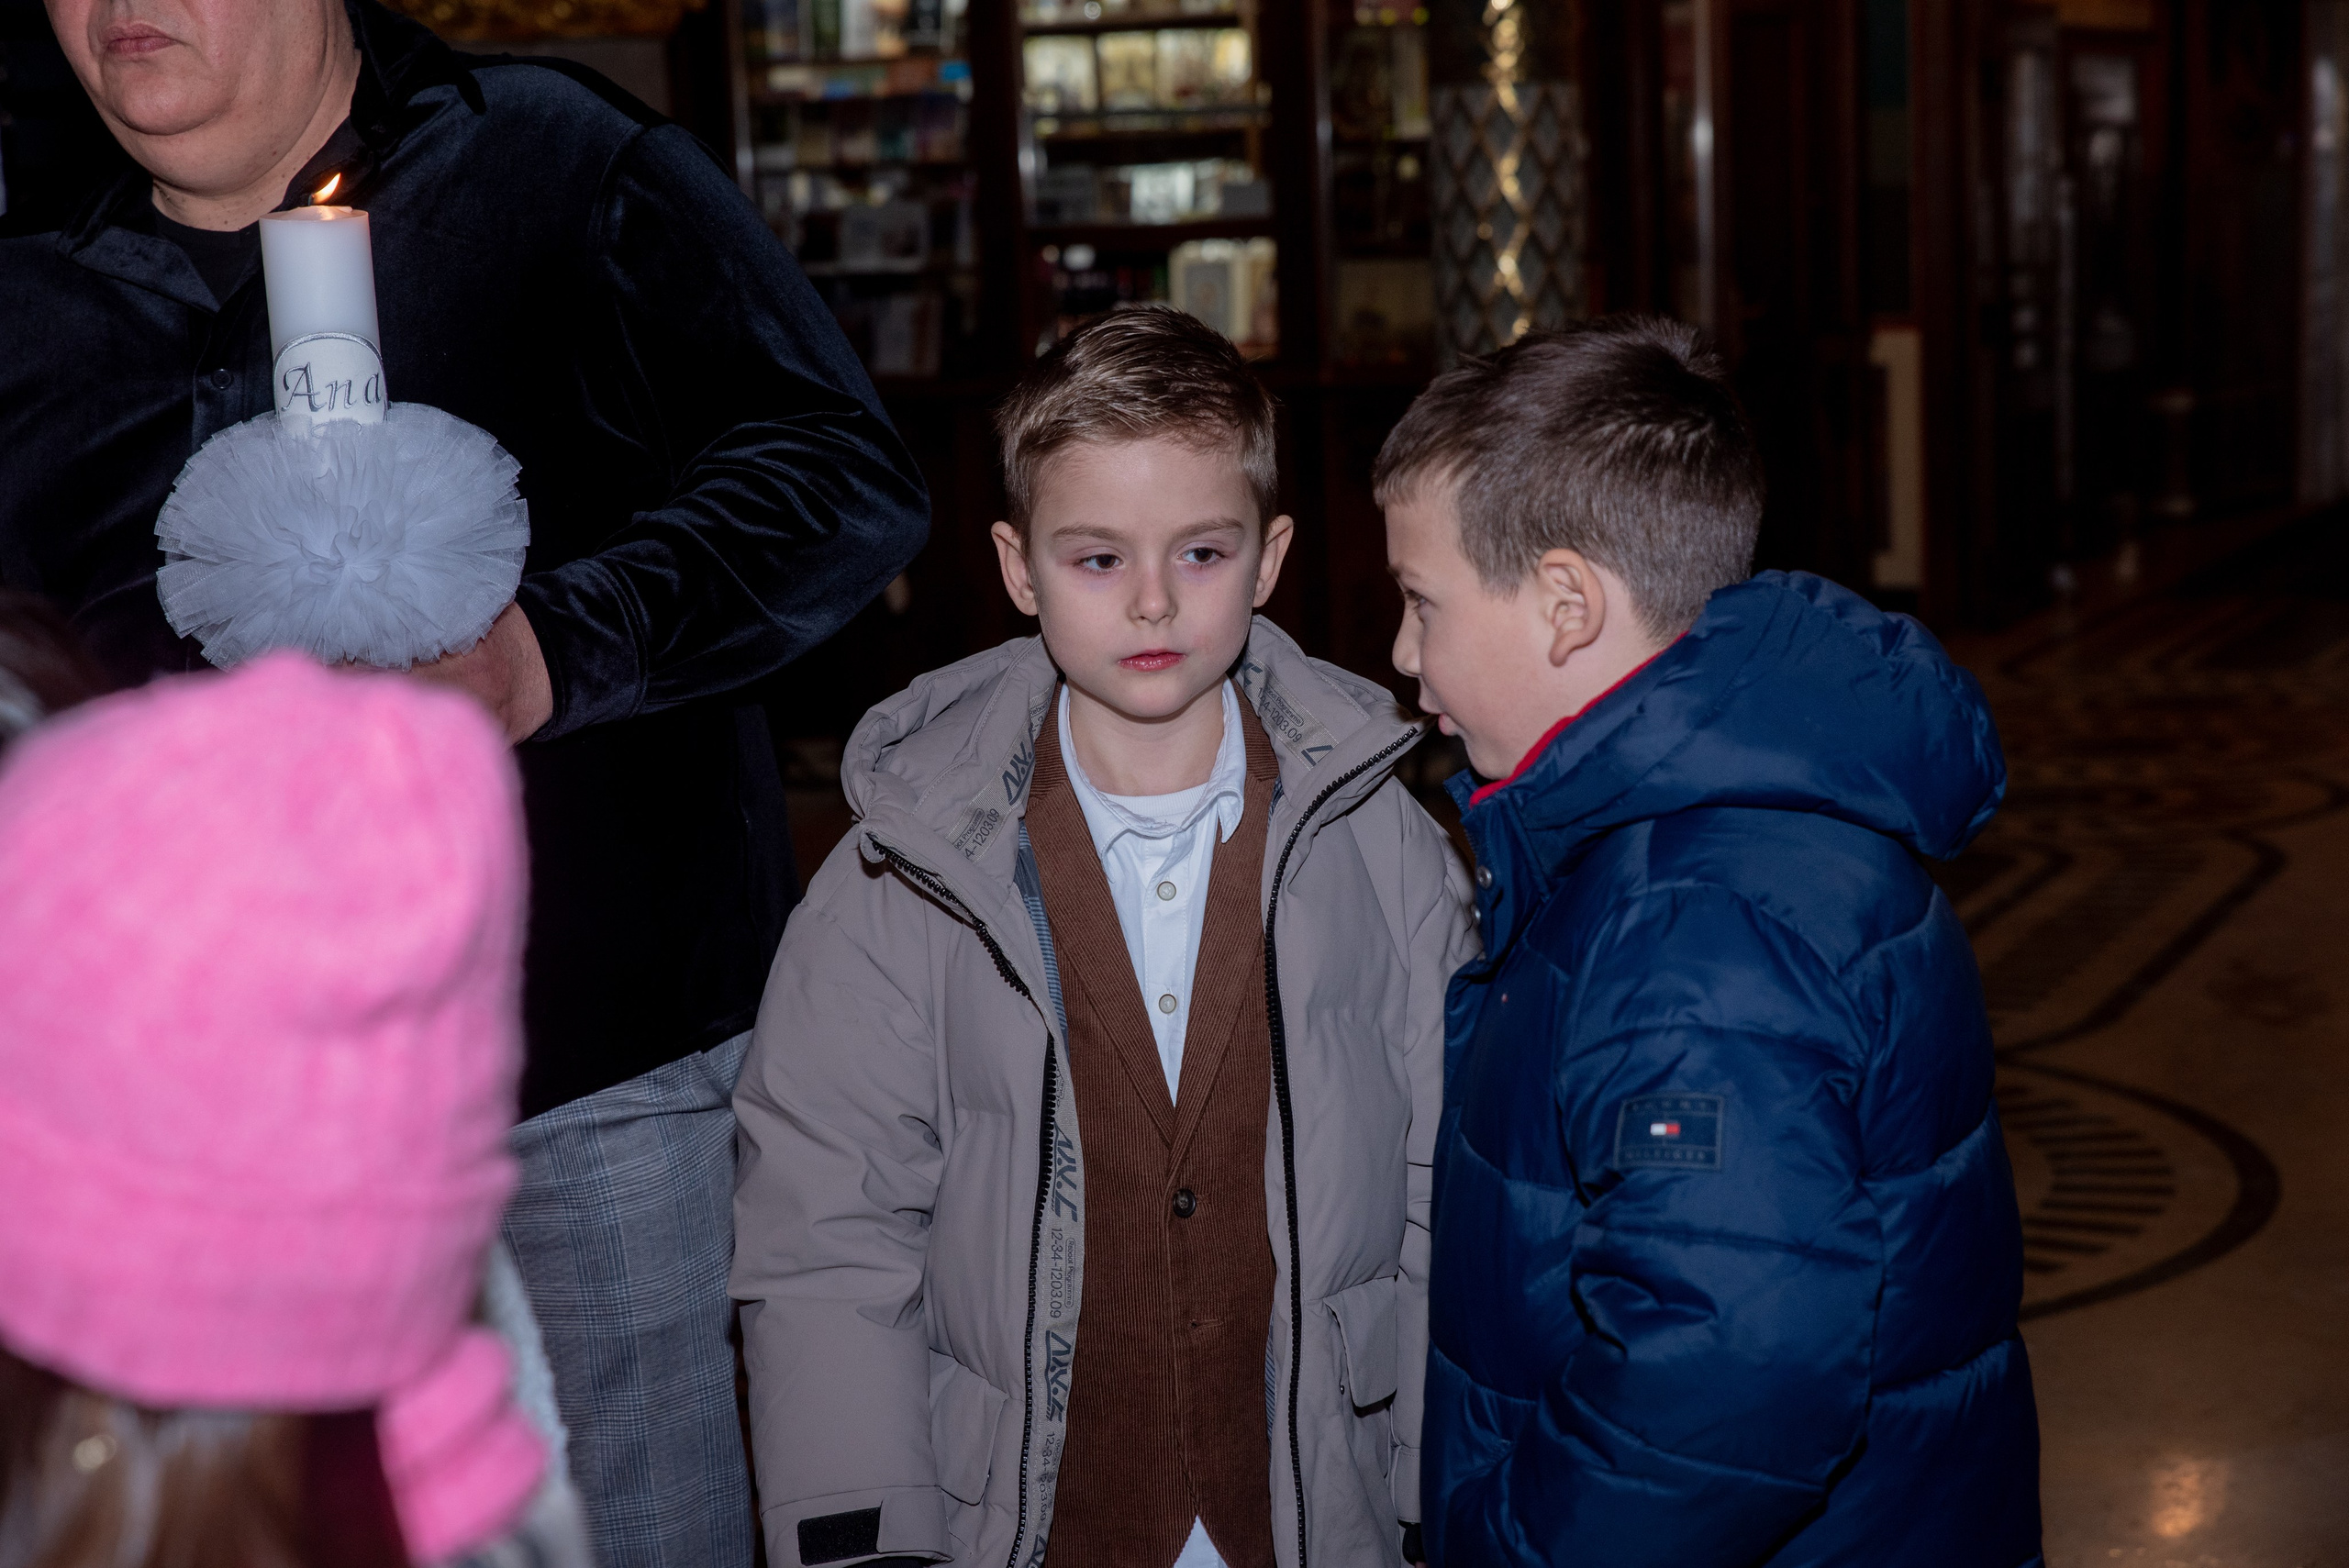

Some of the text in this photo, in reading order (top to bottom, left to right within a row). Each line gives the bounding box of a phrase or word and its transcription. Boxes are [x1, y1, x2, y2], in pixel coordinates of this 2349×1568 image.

[281, 361, 382, 413] Ana
[1276, 697, 1301, 724] Programme
[963, 810, 984, 842] Programme
[964, 807, 1000, 860] 4-1203.09
[1050, 1227, 1063, 1319] 12-34-1203.09
[1065, 1240, 1075, 1306] Reboot Programme
